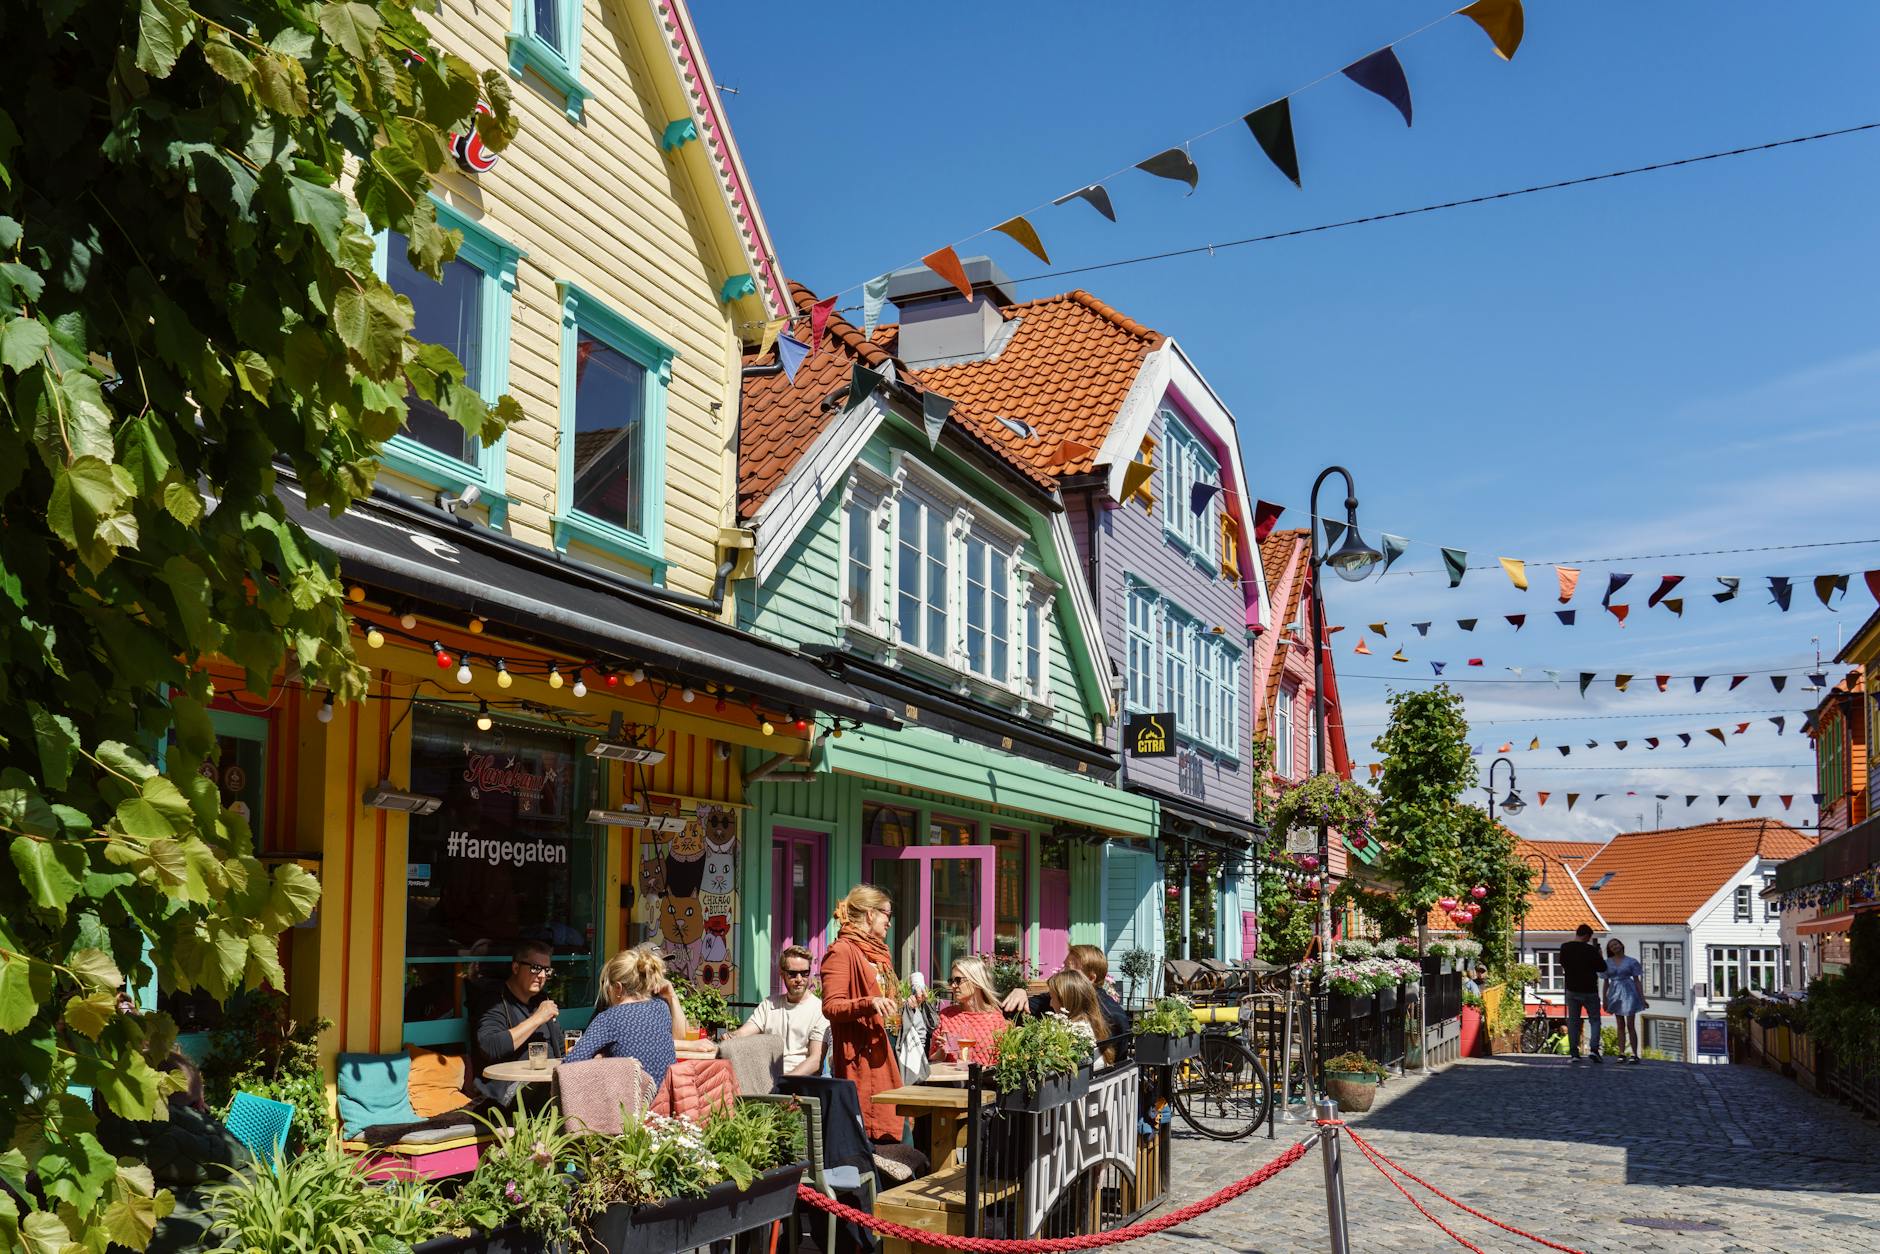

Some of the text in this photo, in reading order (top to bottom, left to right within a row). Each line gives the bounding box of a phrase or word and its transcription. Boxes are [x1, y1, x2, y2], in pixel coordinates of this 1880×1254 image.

[447, 831, 566, 867] #fargegaten
[702, 894, 731, 905] CHICAGO
[709, 905, 728, 914] BULLS
